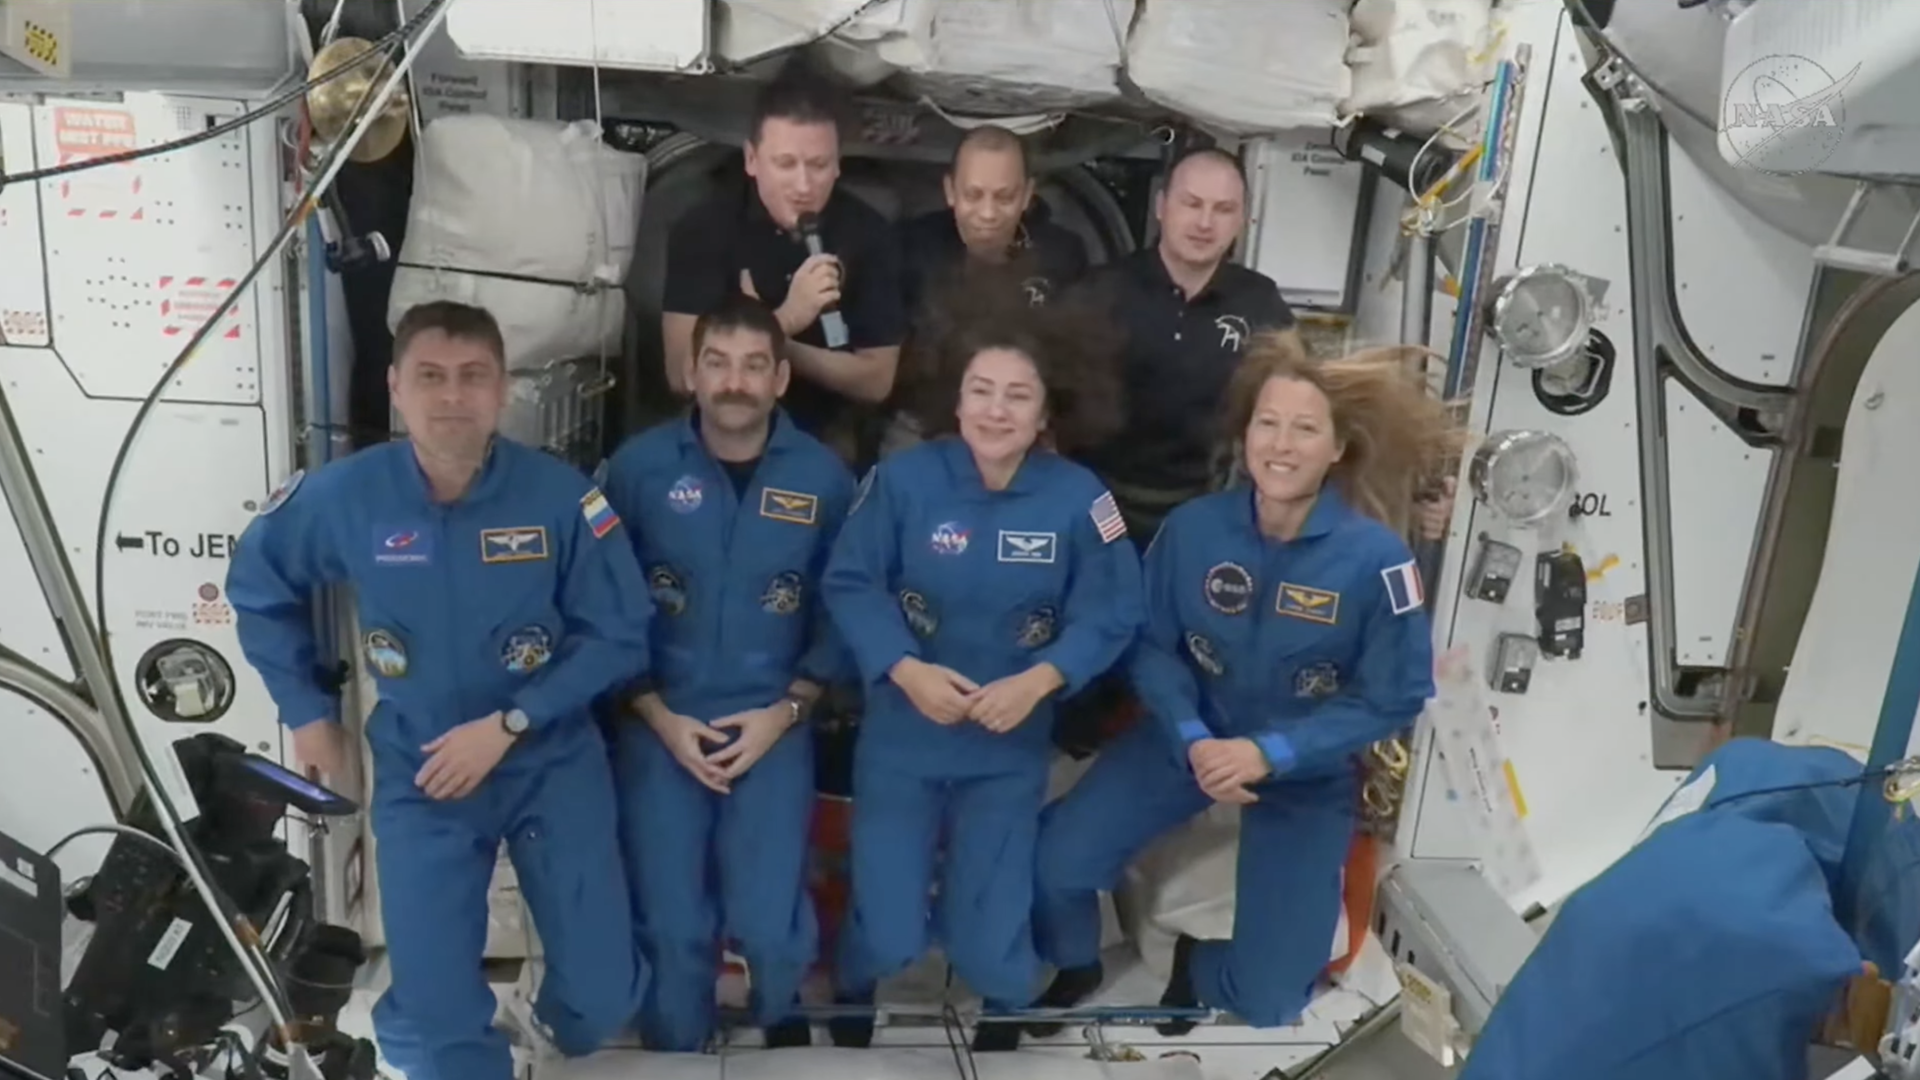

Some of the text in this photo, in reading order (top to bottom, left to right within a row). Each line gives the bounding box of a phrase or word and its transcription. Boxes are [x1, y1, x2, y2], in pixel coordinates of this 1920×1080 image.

[667, 488, 703, 502] NASA
[1572, 492, 1611, 517] OL
[144, 530, 180, 557] To
[931, 531, 968, 549] NASA
